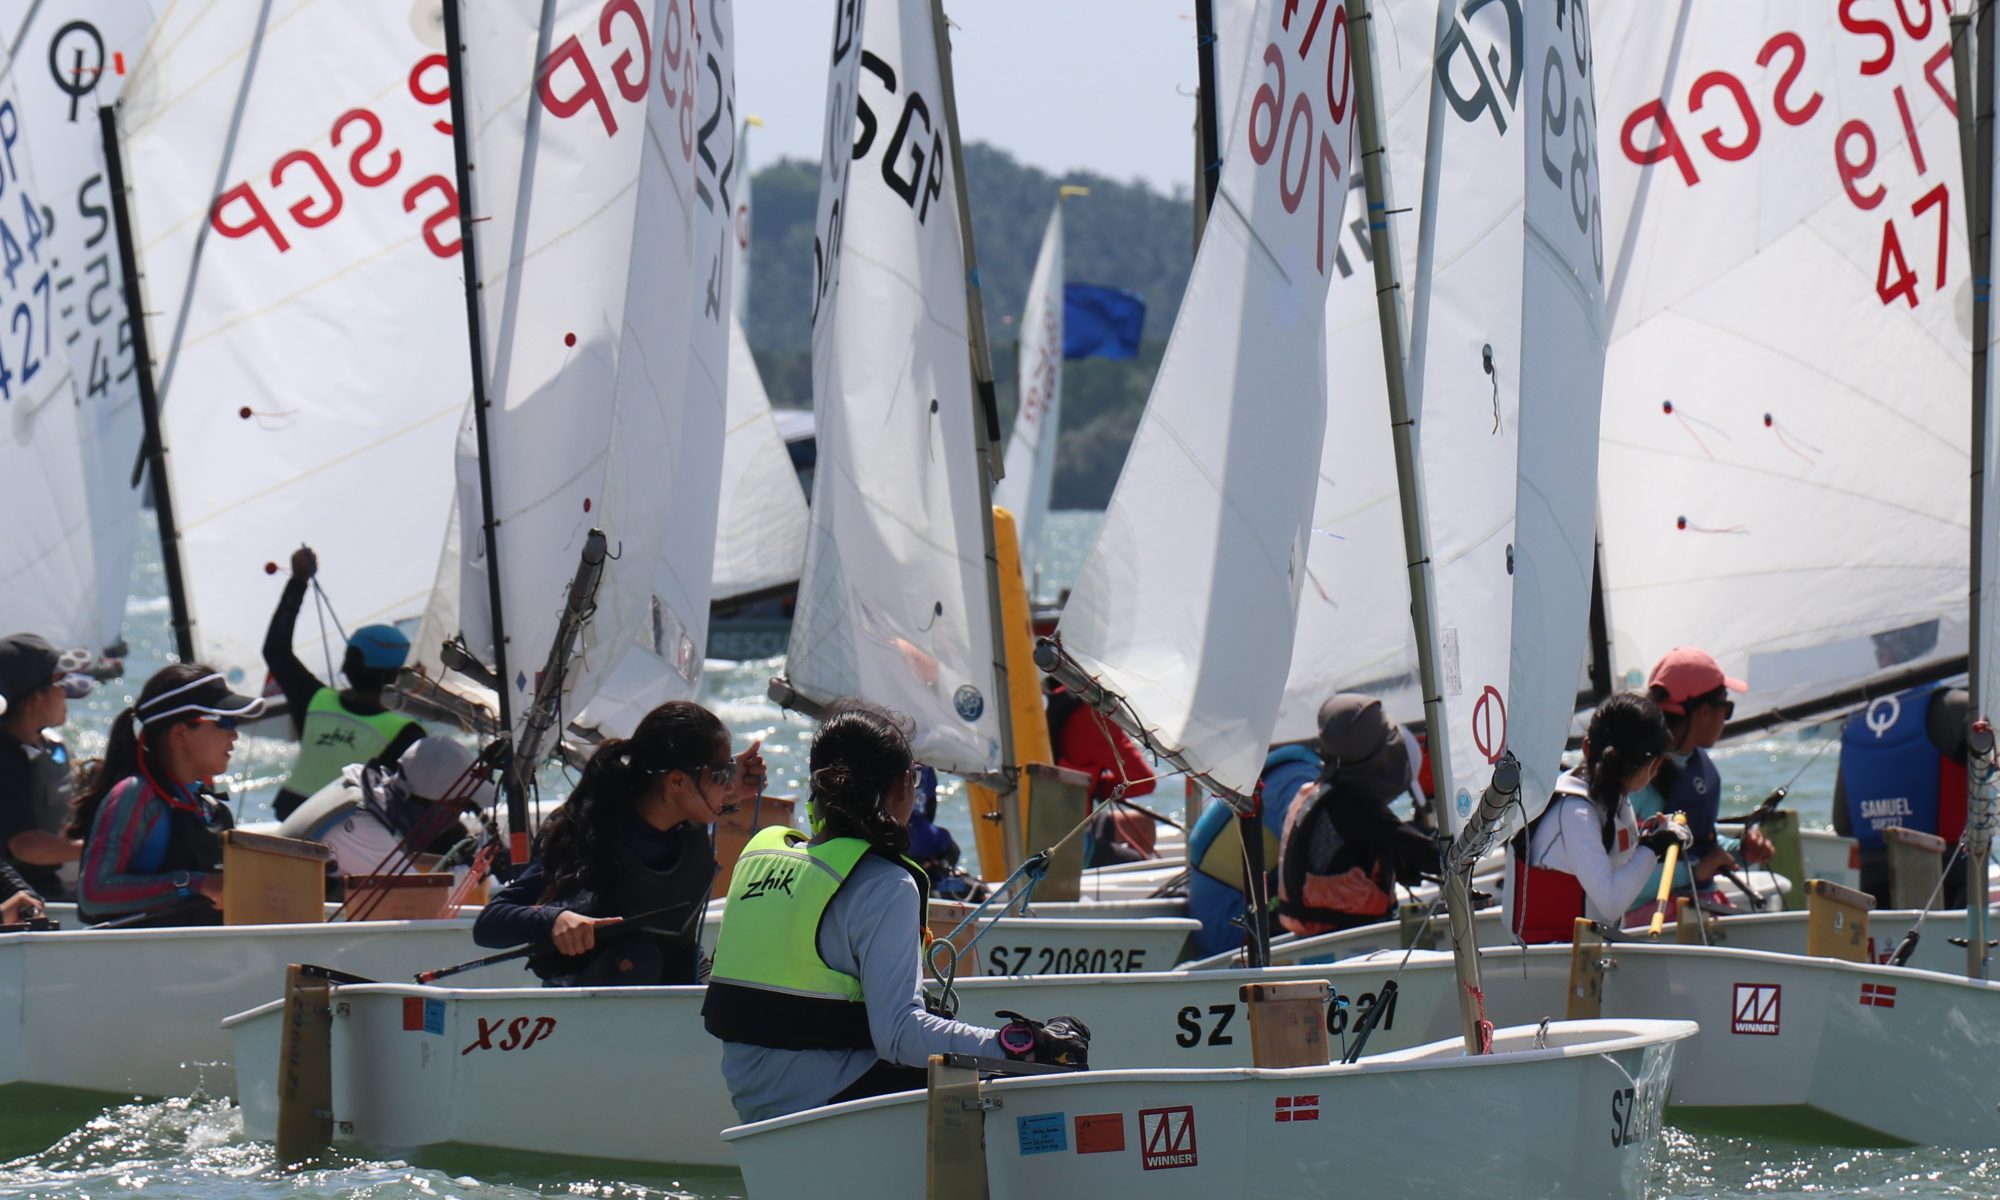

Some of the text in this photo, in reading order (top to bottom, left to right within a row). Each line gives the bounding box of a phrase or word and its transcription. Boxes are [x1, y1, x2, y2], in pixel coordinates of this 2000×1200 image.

[1860, 797, 1912, 818] SAMUEL
[740, 868, 794, 900] zhik
[462, 1016, 557, 1056] XSP
[1735, 1023, 1777, 1033] WINNER
[1147, 1154, 1194, 1167] WINNER
